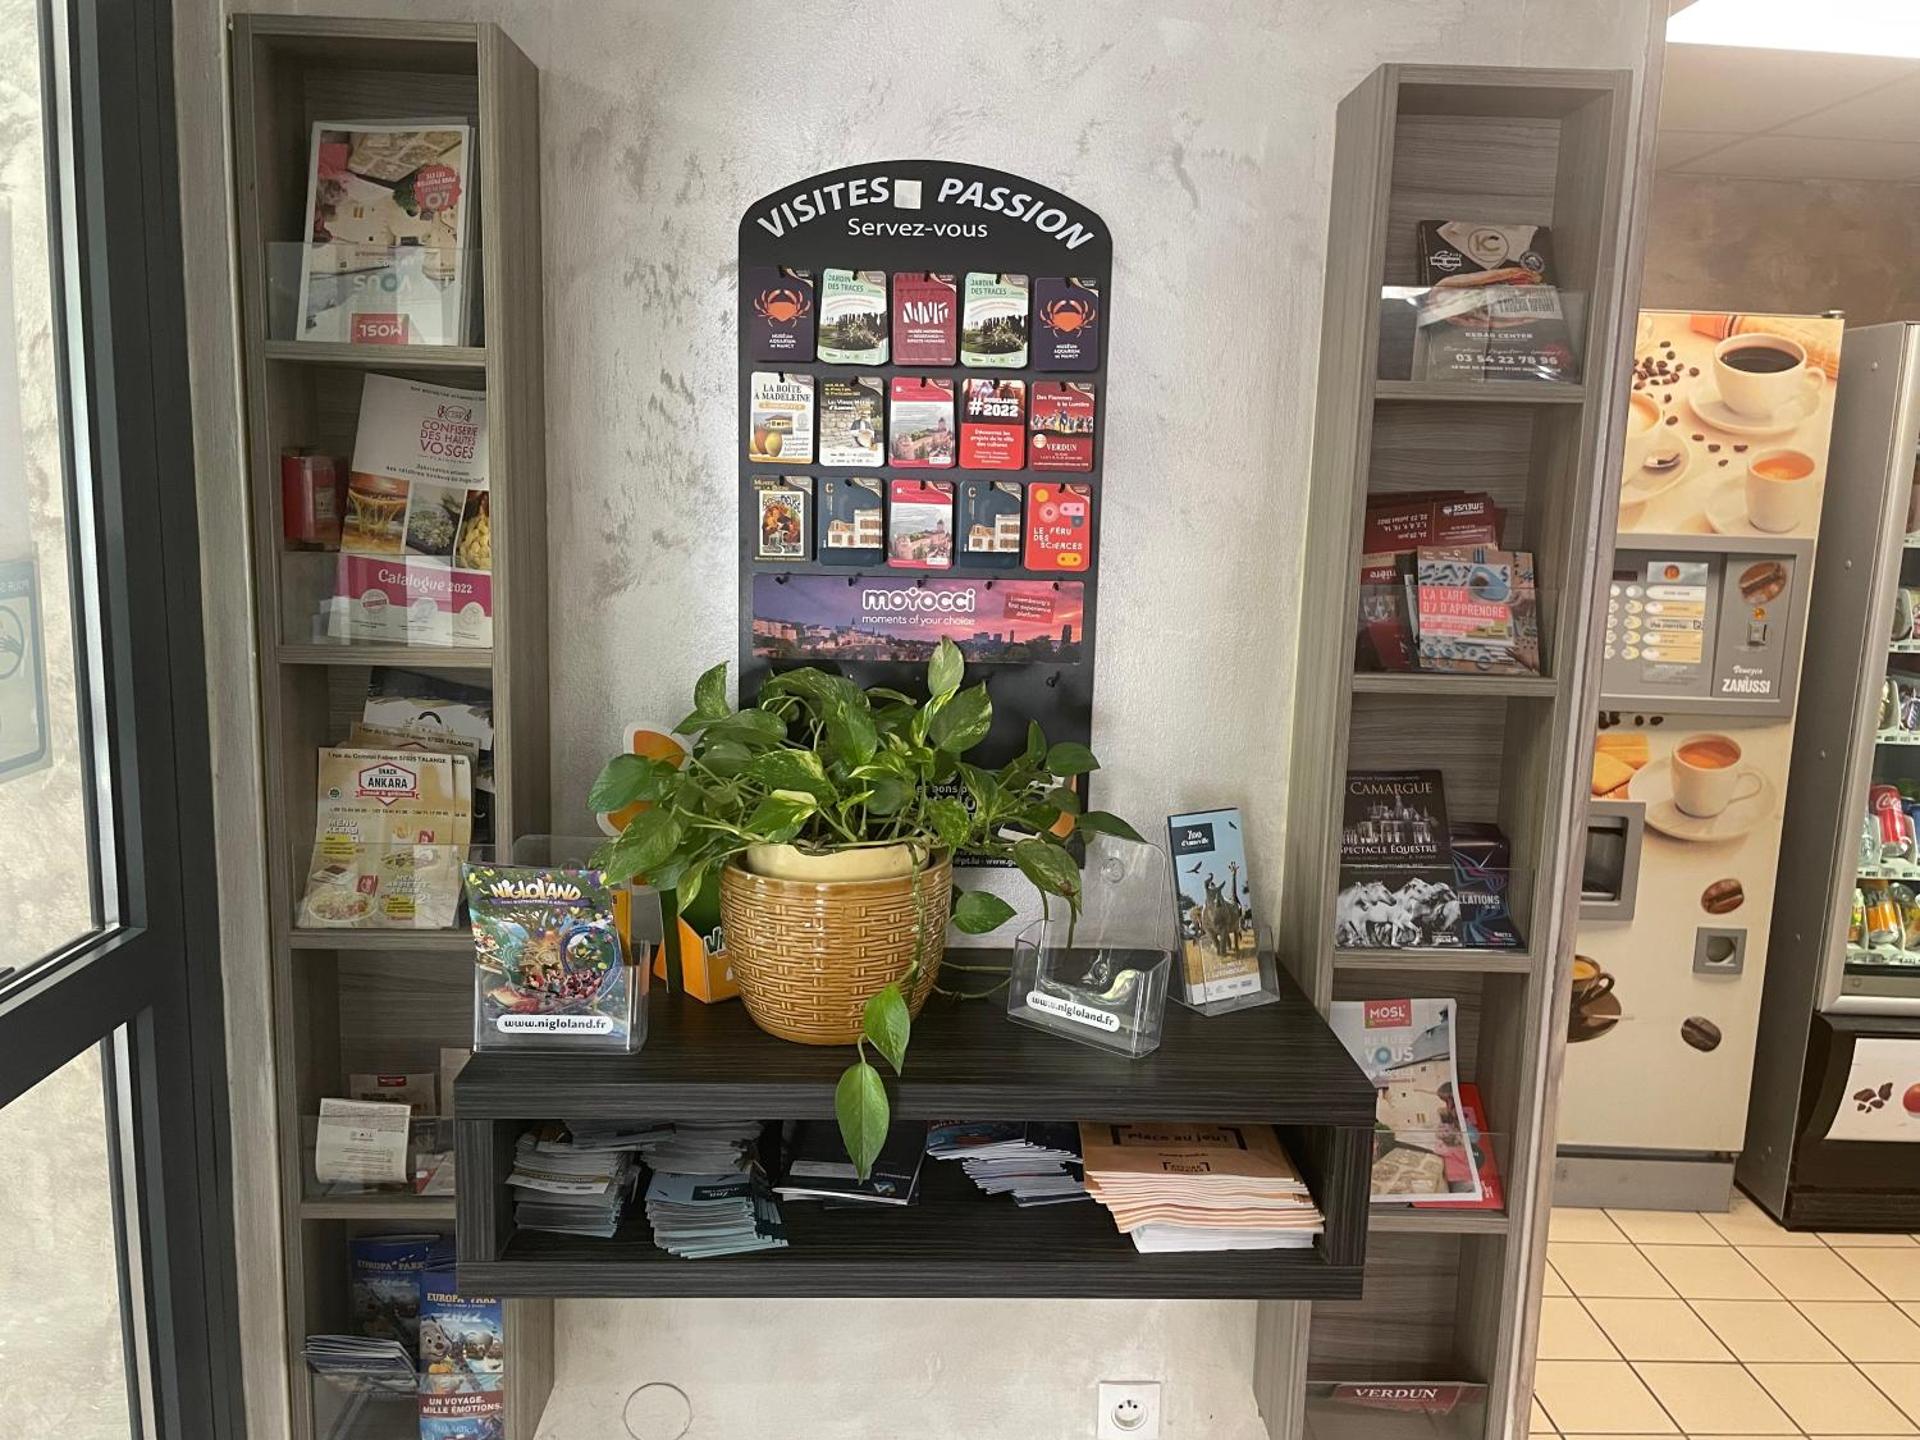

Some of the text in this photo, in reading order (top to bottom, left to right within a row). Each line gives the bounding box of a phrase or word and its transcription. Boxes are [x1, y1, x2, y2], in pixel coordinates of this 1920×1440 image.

[756, 176, 1095, 251] VISITES PASSION
[847, 218, 988, 239] Servez-vous
[970, 279, 993, 287] JARDIN
[984, 288, 1007, 296] TRACES
[359, 324, 402, 337] MOSL
[1456, 354, 1473, 363] 03
[1498, 356, 1515, 364] 22
[763, 384, 775, 393] LA
[422, 420, 479, 437] CONFISERIE
[420, 429, 476, 446] DES HAUTES
[420, 439, 474, 459] VOSGES
[1046, 443, 1078, 452] VERDUN
[1033, 526, 1073, 536] LE FÉRU
[1040, 541, 1083, 551] SCIENCES
[378, 568, 473, 595] Catalogue 2022
[1440, 601, 1506, 618] D'APPRENDRE
[862, 614, 975, 626] moments of your choice
[1721, 677, 1771, 694] ZANUSSI
[368, 776, 408, 789] ANKARA
[1350, 781, 1433, 796] CAMARGUE
[1187, 830, 1203, 840] Zoo
[1390, 843, 1437, 854] ÉQUESTRE
[490, 876, 582, 901] NIGLOLAND
[1031, 994, 1115, 1028] www.nigloland.fr
[1369, 1004, 1406, 1019] MOSL
[504, 1017, 607, 1032] www.nigloland.fr
[1364, 1046, 1415, 1065] VOUS
[1173, 1134, 1192, 1142] au
[1354, 1388, 1439, 1400] VERDUN
[428, 1396, 443, 1406] UN
[423, 1405, 449, 1414] MILLE
